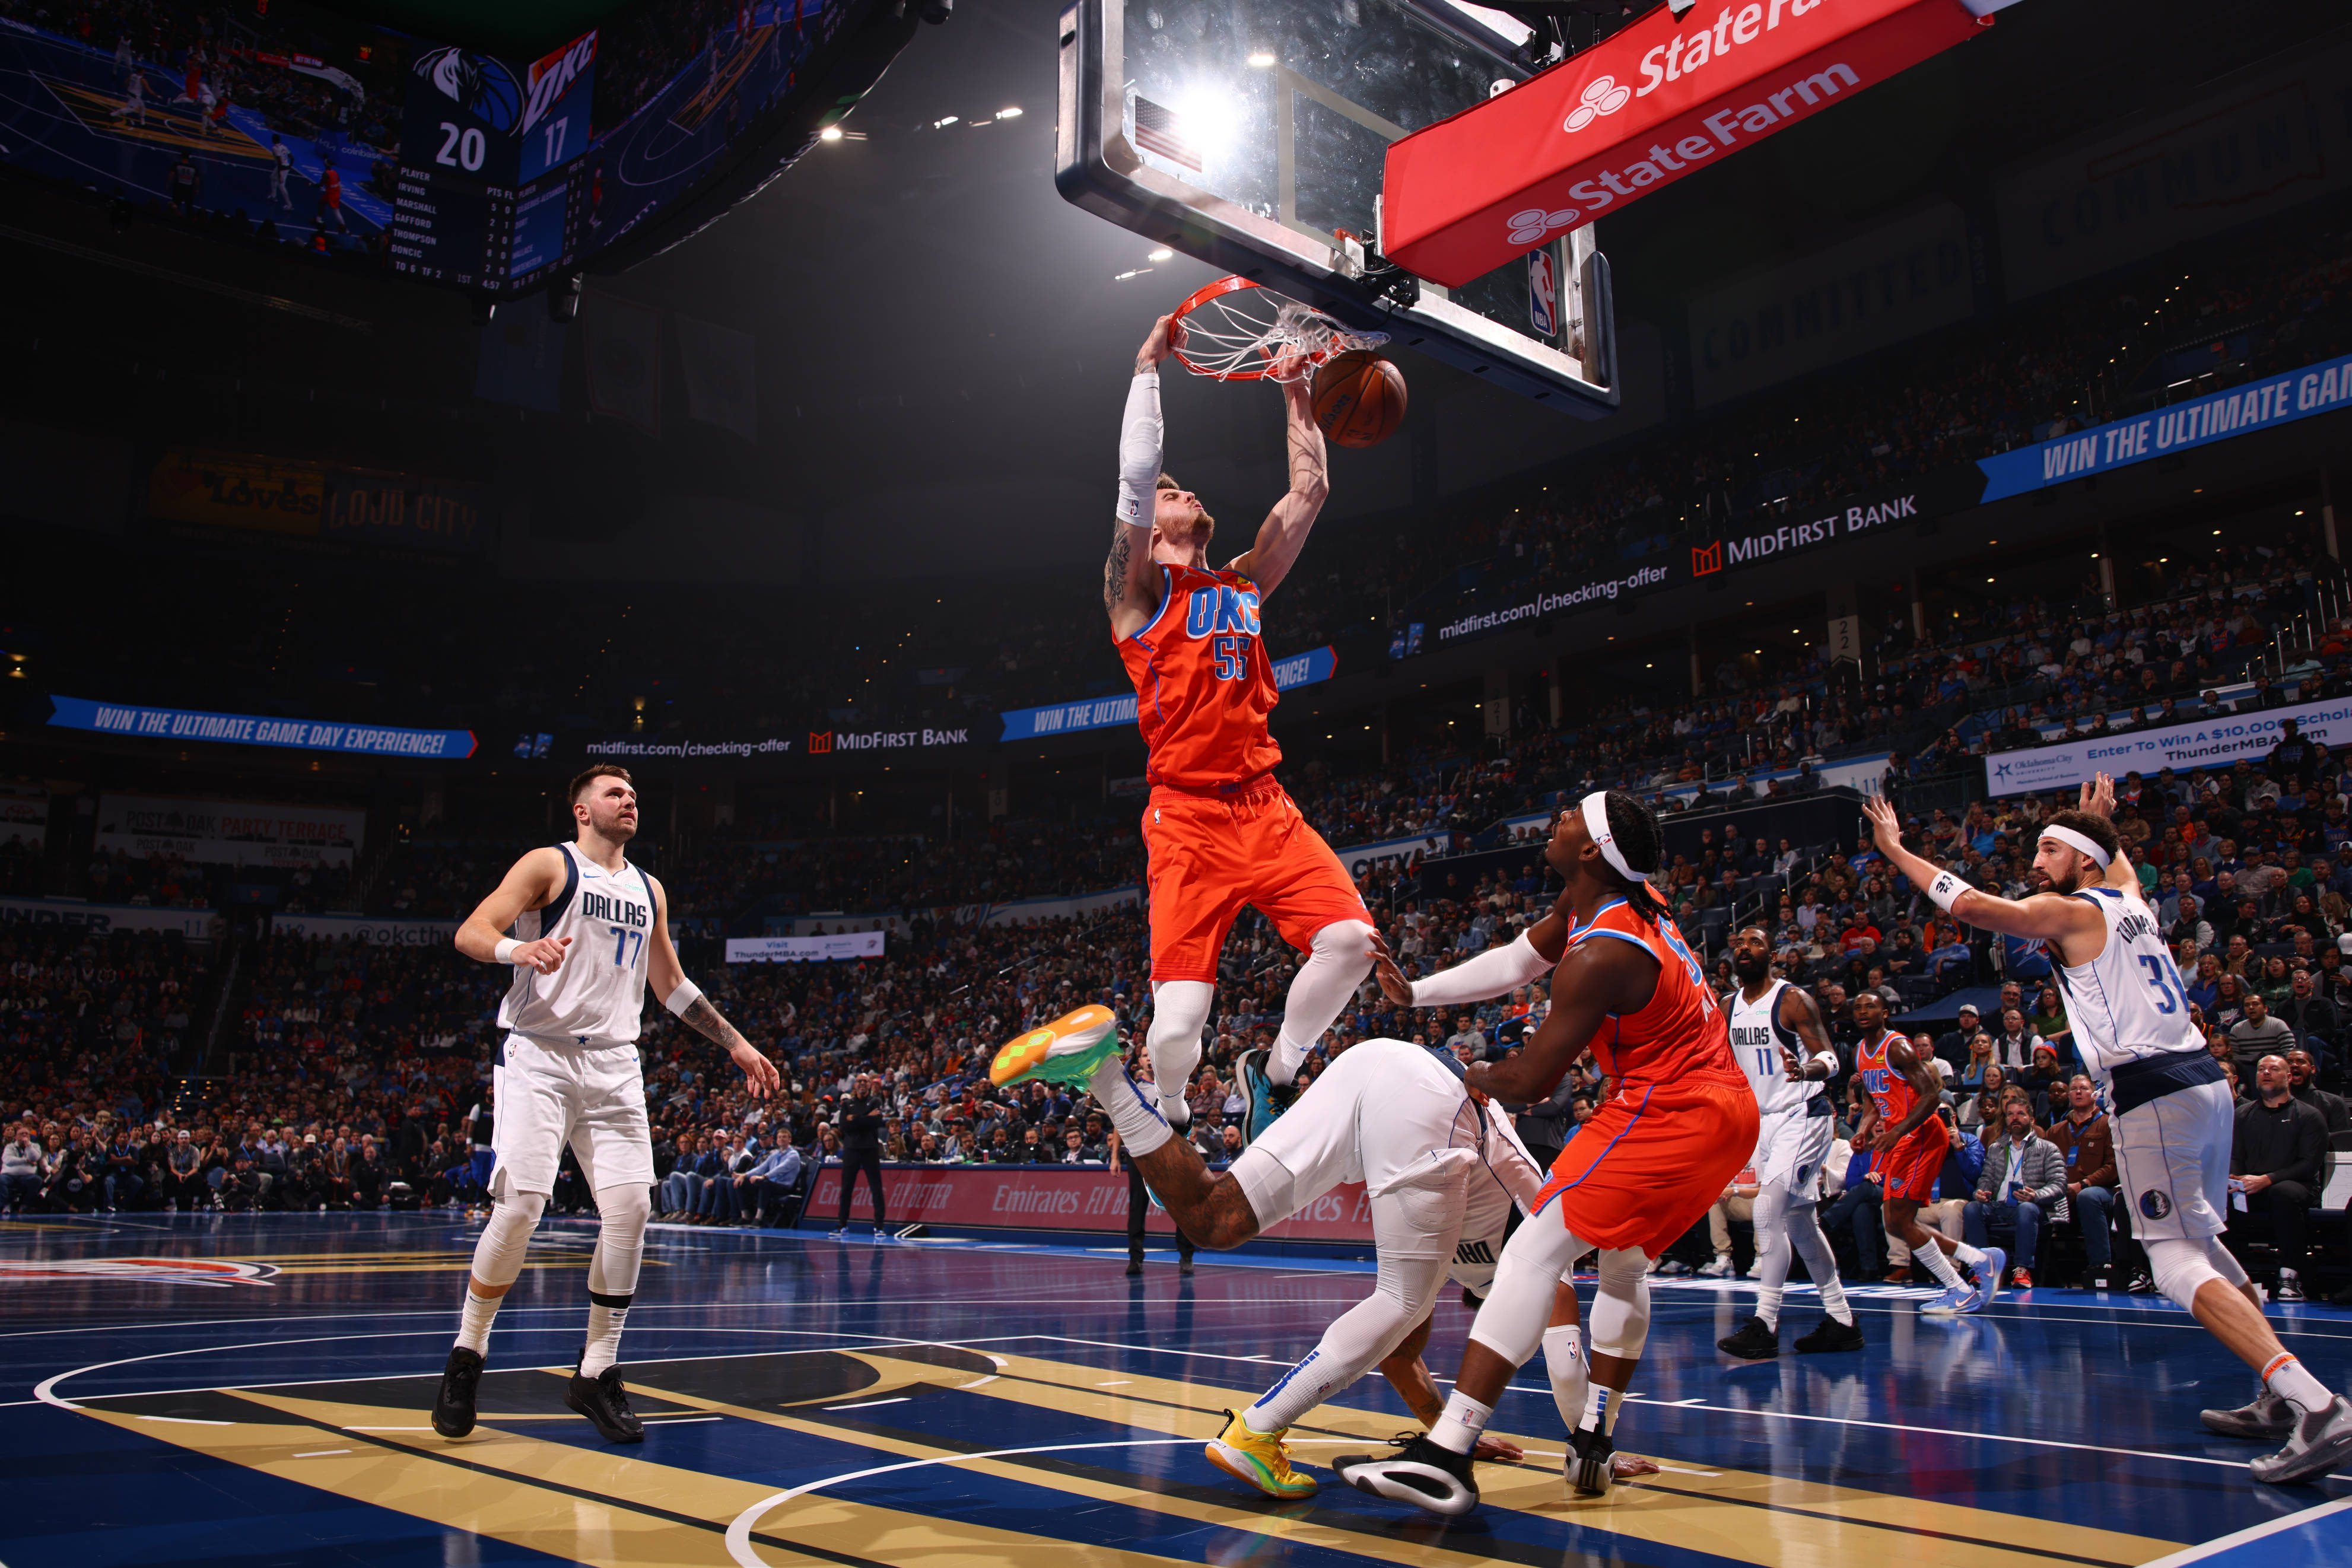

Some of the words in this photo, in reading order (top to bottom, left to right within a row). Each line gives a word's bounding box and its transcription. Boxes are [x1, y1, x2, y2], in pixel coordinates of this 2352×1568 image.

[522, 29, 597, 136] OKC
[341, 147, 382, 160] coinbase
[435, 122, 485, 171] 20
[545, 116, 568, 167] 17
[398, 182, 426, 196] IRVING
[491, 203, 497, 211] 5
[505, 206, 510, 214] 0
[401, 167, 431, 181] PLAYER
[487, 187, 502, 197] PTS
[505, 190, 514, 200] FL
[396, 198, 437, 214] MARSHALL
[489, 218, 495, 227] 2
[393, 228, 437, 246] THOMPSON
[395, 213, 431, 228] GAFFORD
[488, 233, 494, 241] 2
[501, 236, 507, 244] 0
[391, 244, 422, 258] DONCIC
[485, 264, 491, 272] 2
[499, 267, 504, 275] 0
[395, 261, 406, 271] TO
[422, 267, 432, 276] TF
[436, 270, 441, 278] 2
[457, 273, 472, 284] 1ST
[482, 279, 500, 290] 4:57
[1535, 311, 1548, 328] NBA
[1703, 241, 1962, 370] COMMITTED
[2043, 434, 2097, 481] WIN
[2105, 420, 2150, 463] THE
[2156, 380, 2291, 449] ULTIMATE
[417, 492, 477, 543] CITY
[1186, 585, 1261, 640] OKC
[1438, 565, 1668, 641] midfirst.com/checking-offer
[1213, 636, 1251, 680] 55
[95, 707, 136, 730] WIN
[138, 711, 171, 733] THE
[171, 715, 253, 740] ULTIMATE
[255, 722, 307, 745] GAME
[308, 725, 343, 747] DAY
[344, 727, 446, 755] EXPERIENCE!
[1033, 708, 1066, 733] WIN
[1066, 705, 1092, 729] THE
[586, 738, 791, 758] midfirst.com/checking-offer
[2087, 745, 2132, 760] Enter
[2134, 740, 2154, 751] To
[2159, 734, 2191, 749] Win
[2195, 732, 2208, 742] A
[2015, 758, 2055, 769] Oklahoma
[2056, 755, 2073, 764] City
[126, 810, 163, 828] POST
[187, 815, 216, 832] OAK
[221, 816, 272, 835] PARTY
[278, 820, 347, 841] TERRACE
[136, 838, 162, 850] POST
[176, 840, 196, 853] OAK
[265, 845, 288, 859] POST
[302, 848, 322, 860] OAK
[625, 883, 644, 893] chime
[1936, 874, 1951, 893] 31
[582, 891, 647, 928] DALLAS
[609, 926, 643, 969] 77
[735, 950, 818, 958] ThunderMBA.com
[2137, 953, 2191, 1014] 31
[1732, 1027, 1769, 1045] DALLAS
[1756, 1048, 1773, 1076] 11
[1862, 1068, 1890, 1094] OKC
[889, 1183, 910, 1208] FLY
[908, 1183, 953, 1210] BETTER
[991, 1184, 1080, 1214] Emirates
[1085, 1186, 1116, 1215] FLY
